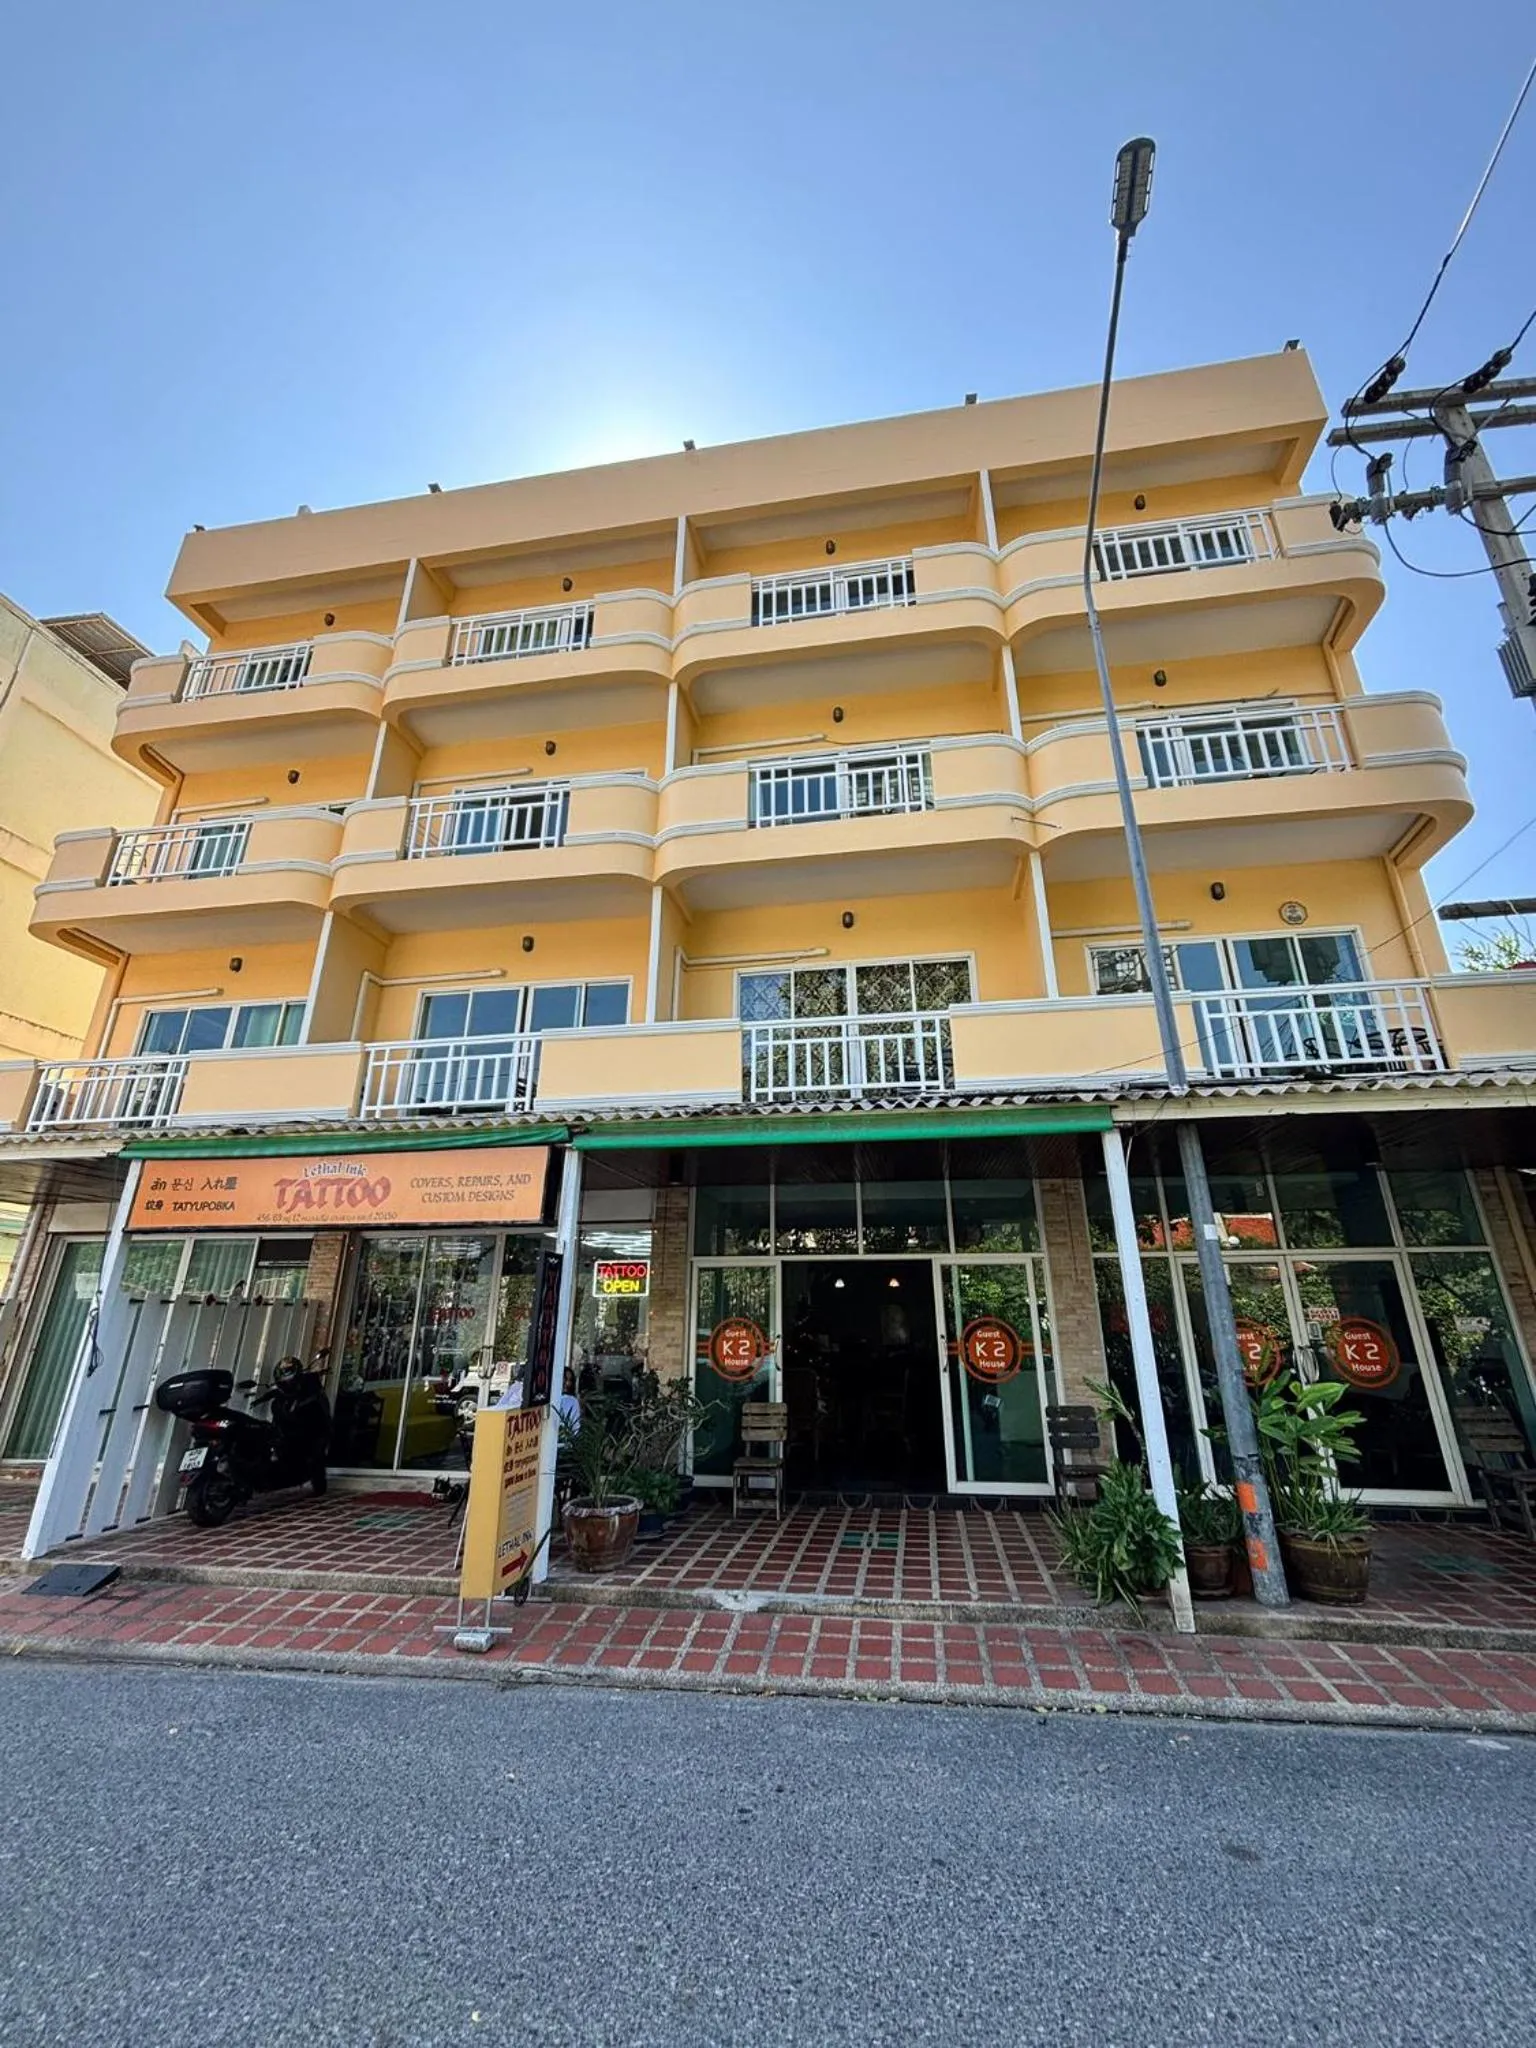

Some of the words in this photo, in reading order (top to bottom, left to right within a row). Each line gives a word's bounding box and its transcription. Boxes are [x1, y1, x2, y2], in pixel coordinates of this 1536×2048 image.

[303, 1161, 342, 1178] Lethal
[345, 1162, 367, 1177] Ink
[410, 1176, 454, 1189] COVERS,
[457, 1175, 503, 1188] REPAIRS,
[506, 1173, 532, 1186] AND
[273, 1176, 392, 1214] TATTOO
[421, 1191, 465, 1204] CUSTOM
[467, 1189, 515, 1203] DESIGNS
[598, 1264, 647, 1280] TATTOO
[603, 1280, 640, 1293] OPEN
[725, 1329, 747, 1338] Guest
[976, 1330, 1001, 1339] Guest
[1344, 1331, 1372, 1341] Guest
[724, 1358, 749, 1367] House
[979, 1360, 1006, 1369] House
[1351, 1363, 1383, 1372] House
[506, 1409, 541, 1441] TATTOO
